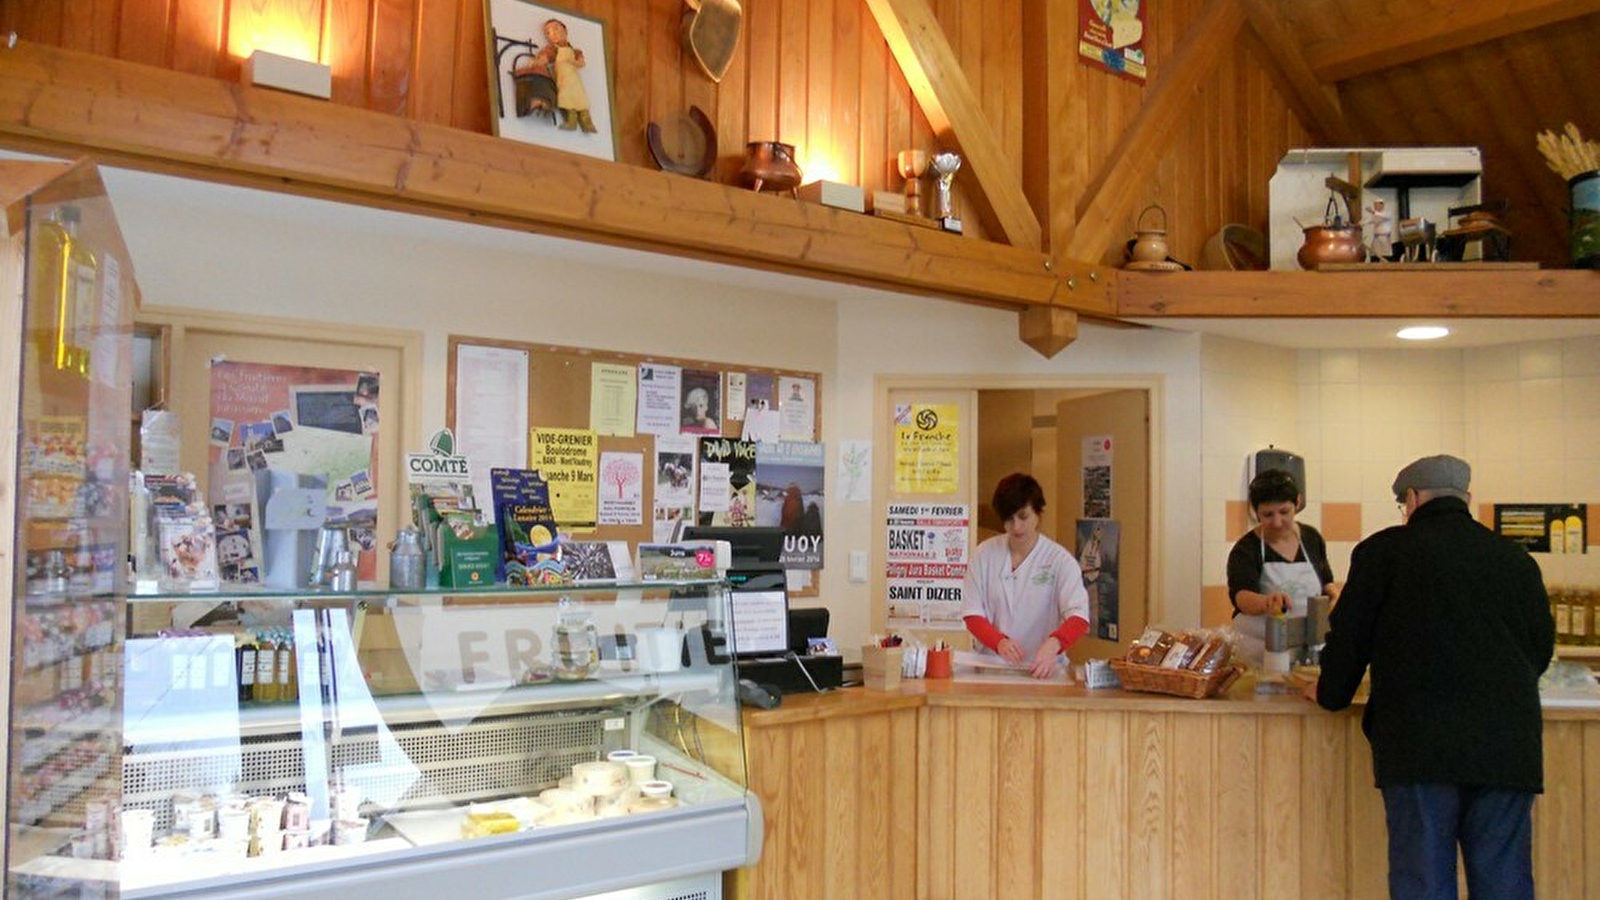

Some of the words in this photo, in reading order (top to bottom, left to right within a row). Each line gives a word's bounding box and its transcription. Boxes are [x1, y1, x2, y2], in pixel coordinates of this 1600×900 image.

[536, 433, 593, 447] VIDE-GRENIER
[545, 444, 588, 457] Boulodrome
[409, 457, 469, 474] COMTÉ
[577, 470, 594, 482] Mars
[889, 505, 919, 515] SAMEDI
[931, 506, 964, 516] FEVRIER
[889, 529, 925, 550] BASKET
[889, 551, 929, 559] NATIONALE
[889, 586, 922, 600] SAINT
[926, 587, 962, 601] DIZIER
